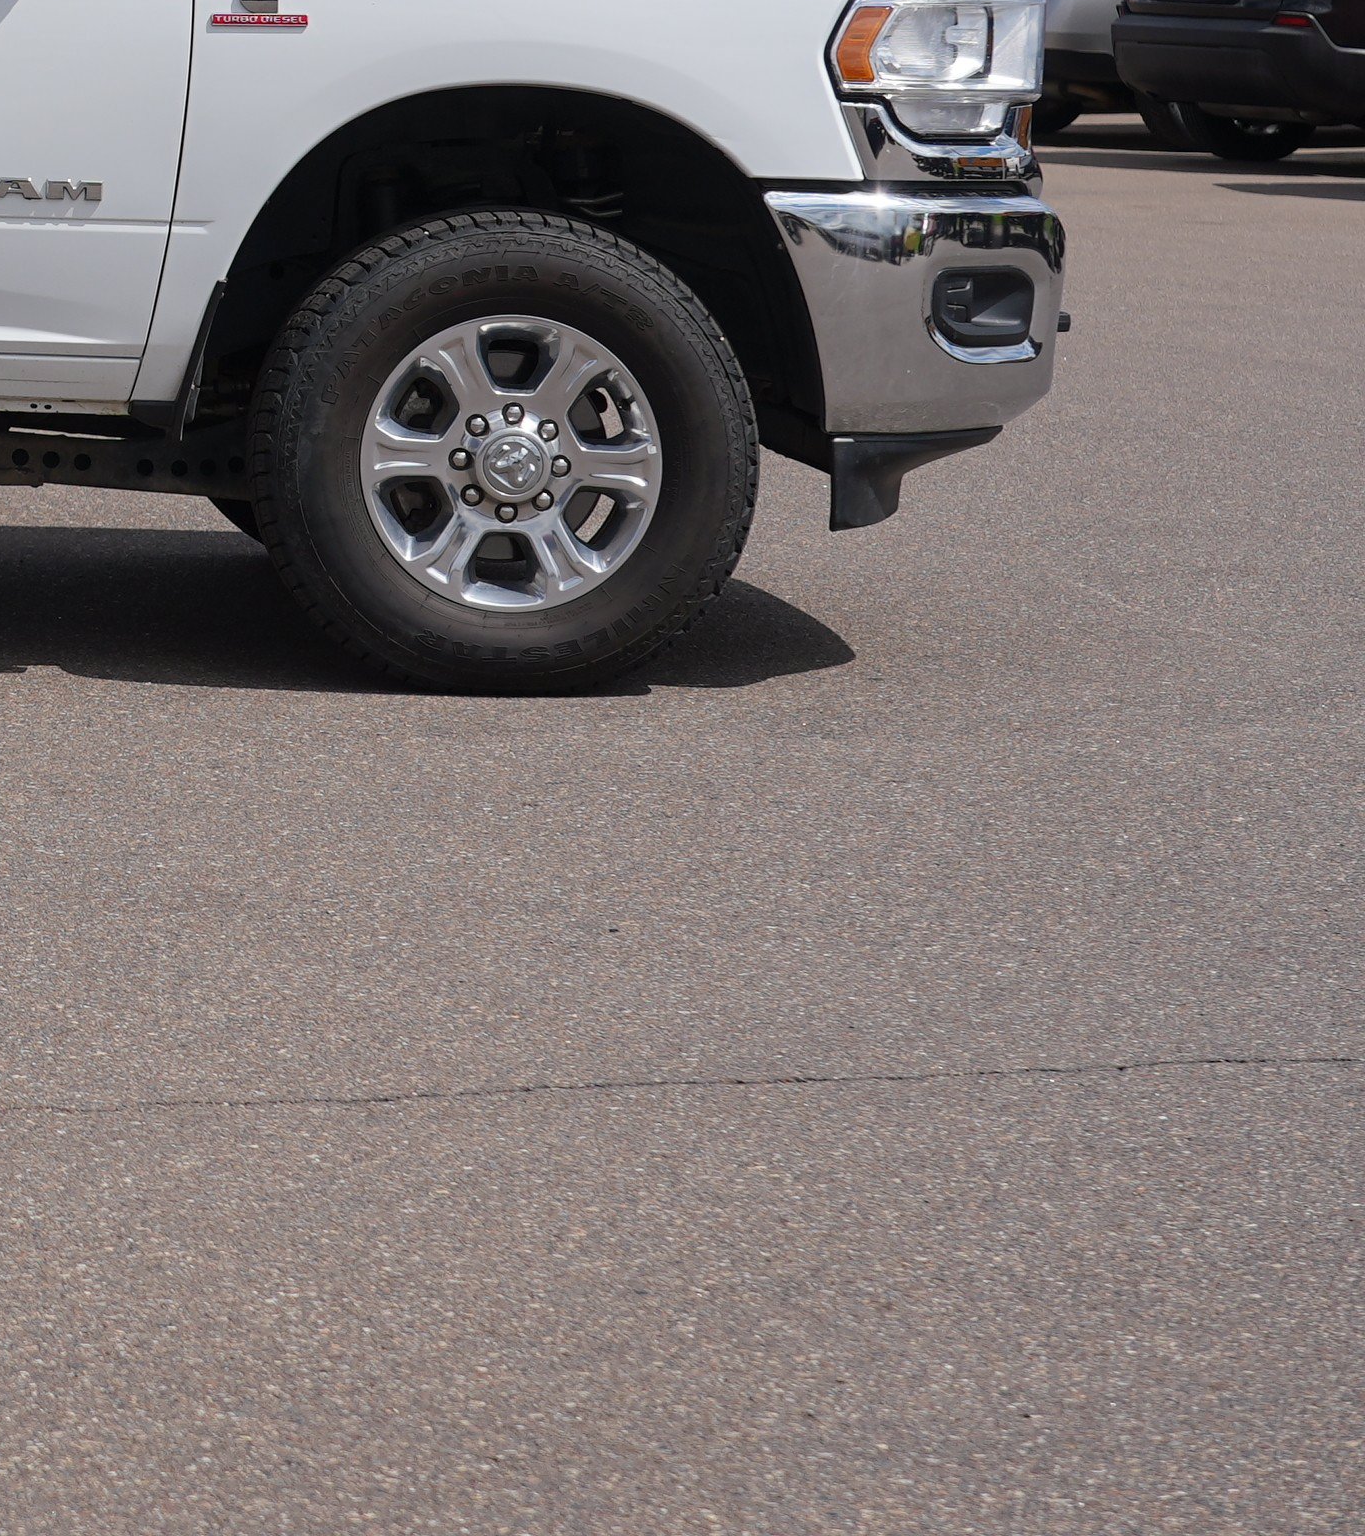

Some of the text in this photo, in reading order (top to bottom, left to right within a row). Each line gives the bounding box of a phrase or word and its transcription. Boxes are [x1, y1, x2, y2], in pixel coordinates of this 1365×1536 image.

[214, 15, 307, 24] TURBO DIESEL
[321, 264, 540, 405] PATAGONIA
[411, 586, 664, 667] MILESTAR
